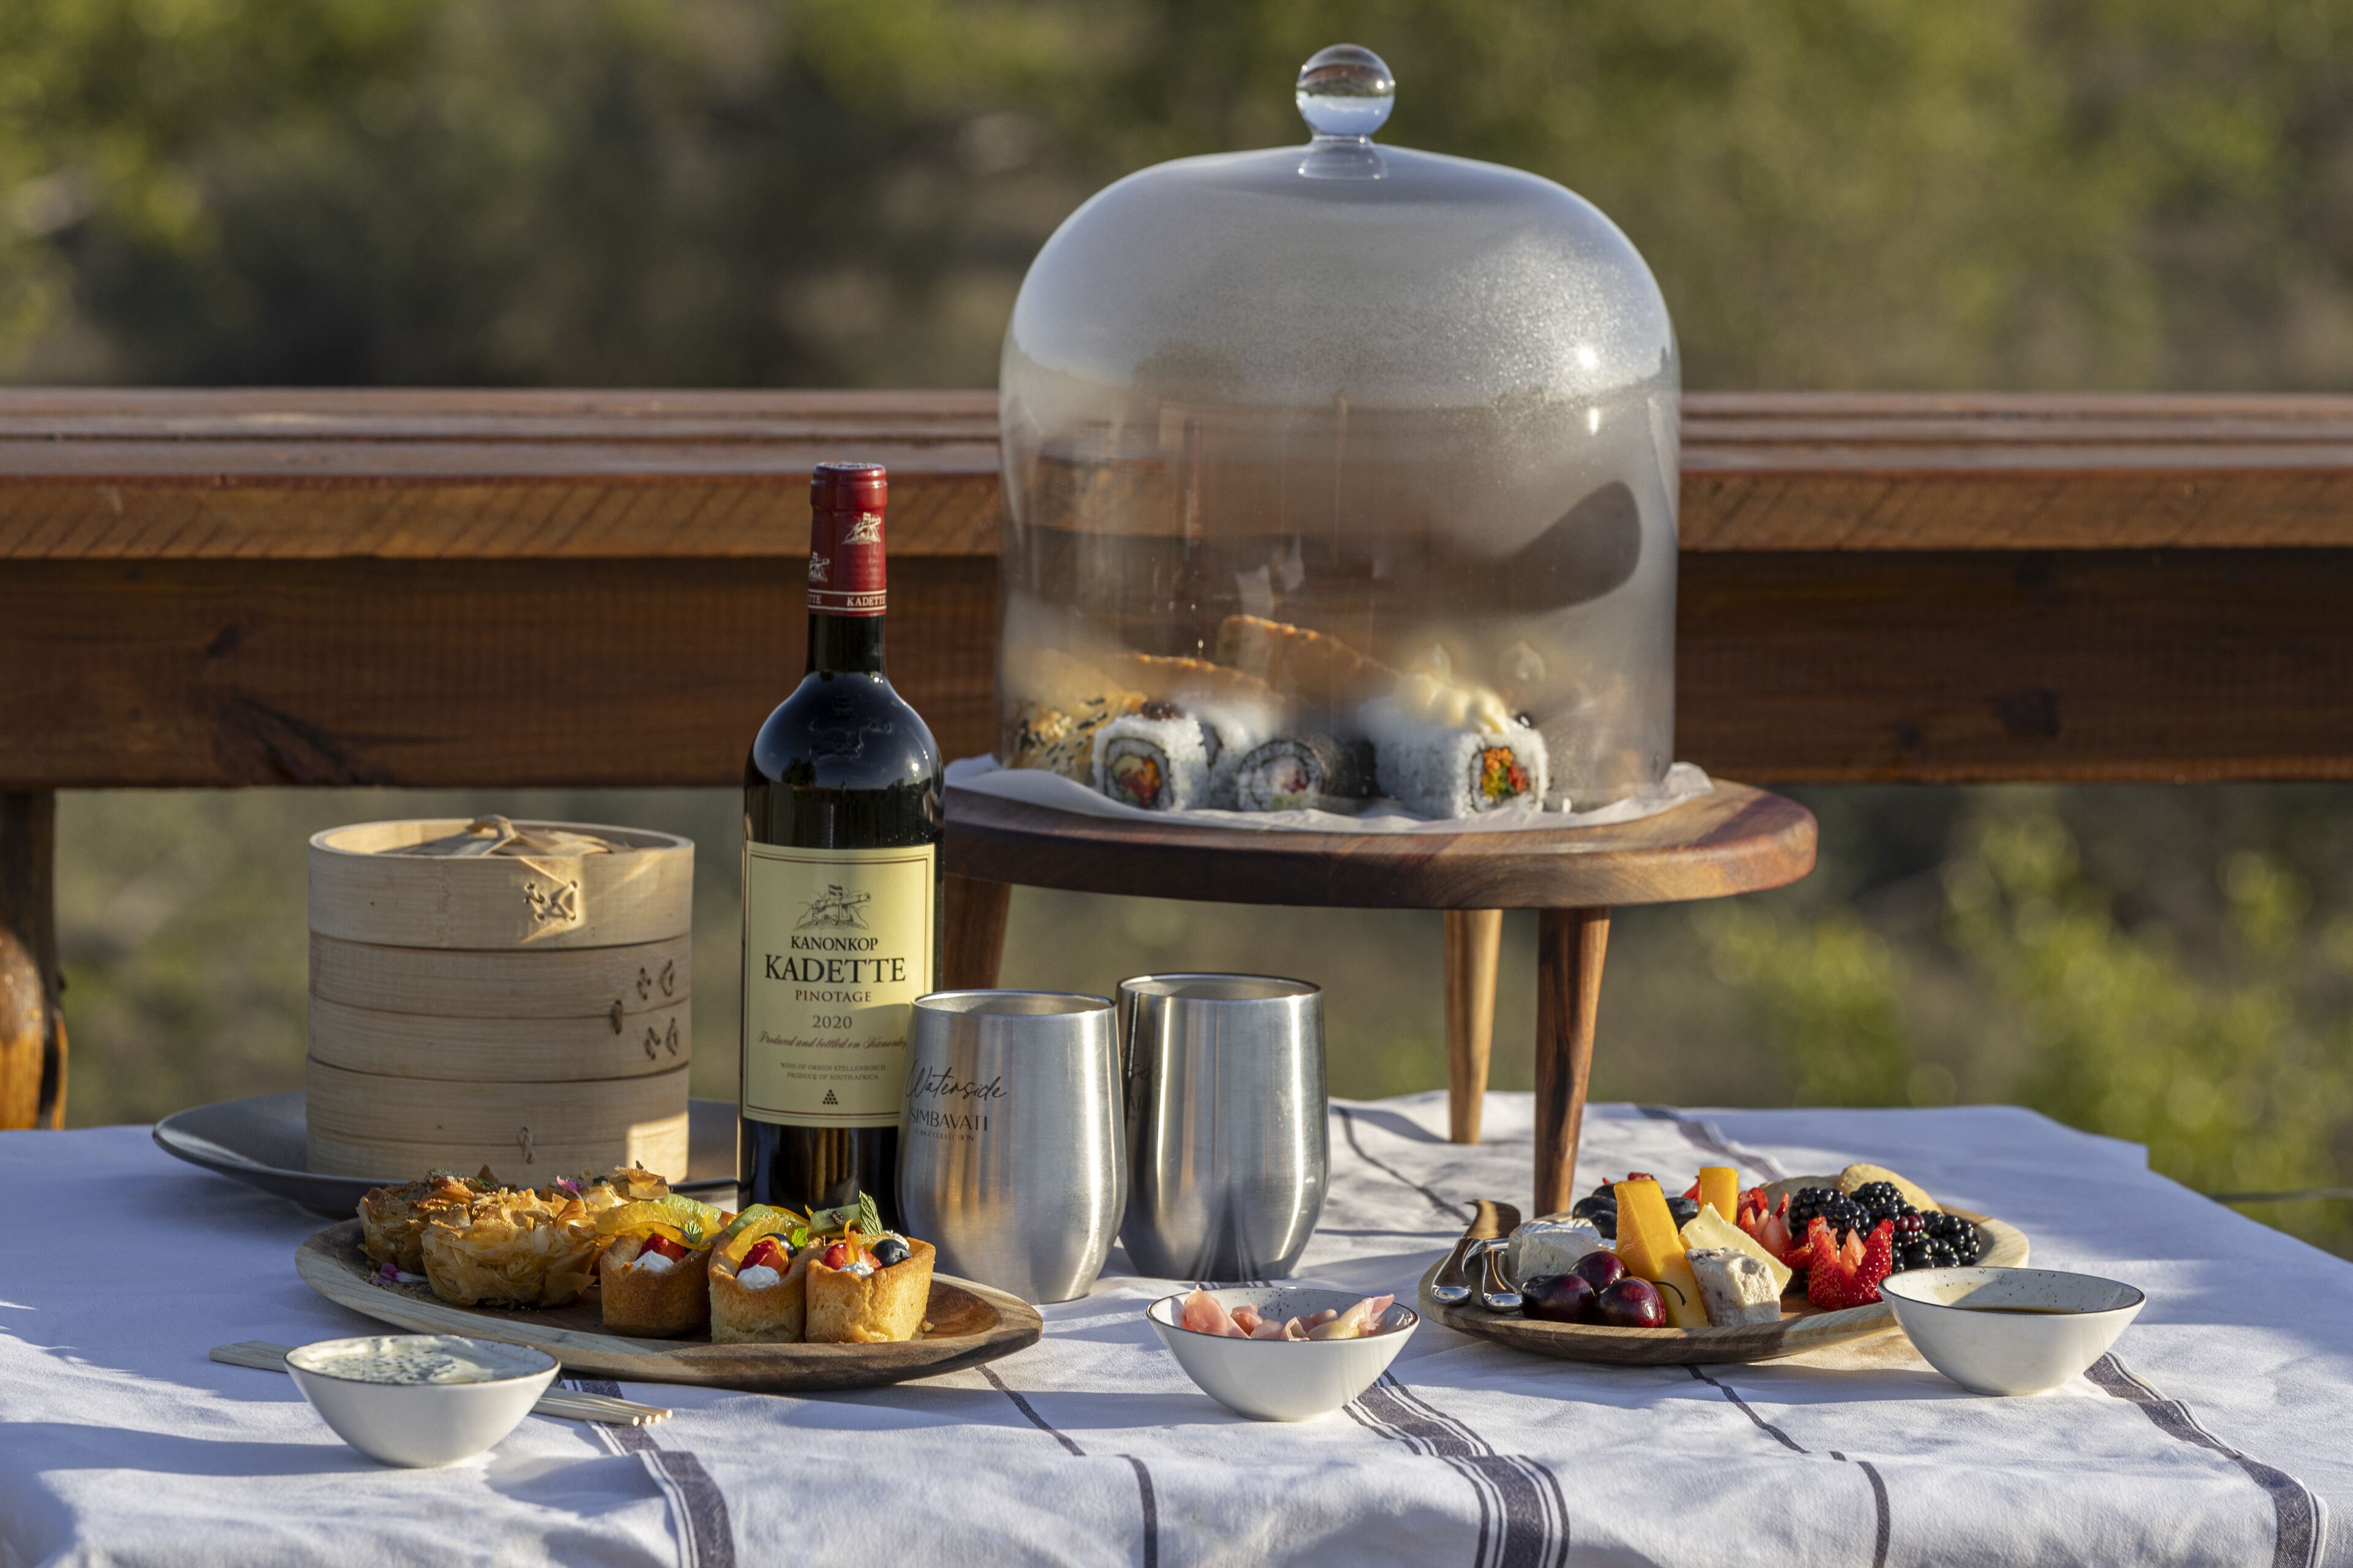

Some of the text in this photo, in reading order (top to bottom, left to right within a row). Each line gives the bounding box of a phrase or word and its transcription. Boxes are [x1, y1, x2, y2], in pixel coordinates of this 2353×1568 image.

[790, 935, 878, 951] KANONKOP
[765, 953, 906, 984] KADETTE
[795, 989, 872, 1003] PINOTAGE
[812, 1015, 852, 1029] 2020
[757, 1030, 797, 1046] Produced
[795, 1037, 817, 1048] and
[816, 1037, 849, 1048] bottled
[787, 1071, 817, 1080] PRODUCE
[906, 1059, 1007, 1102] Waterside
[911, 1107, 988, 1131] SIMBAVATI
